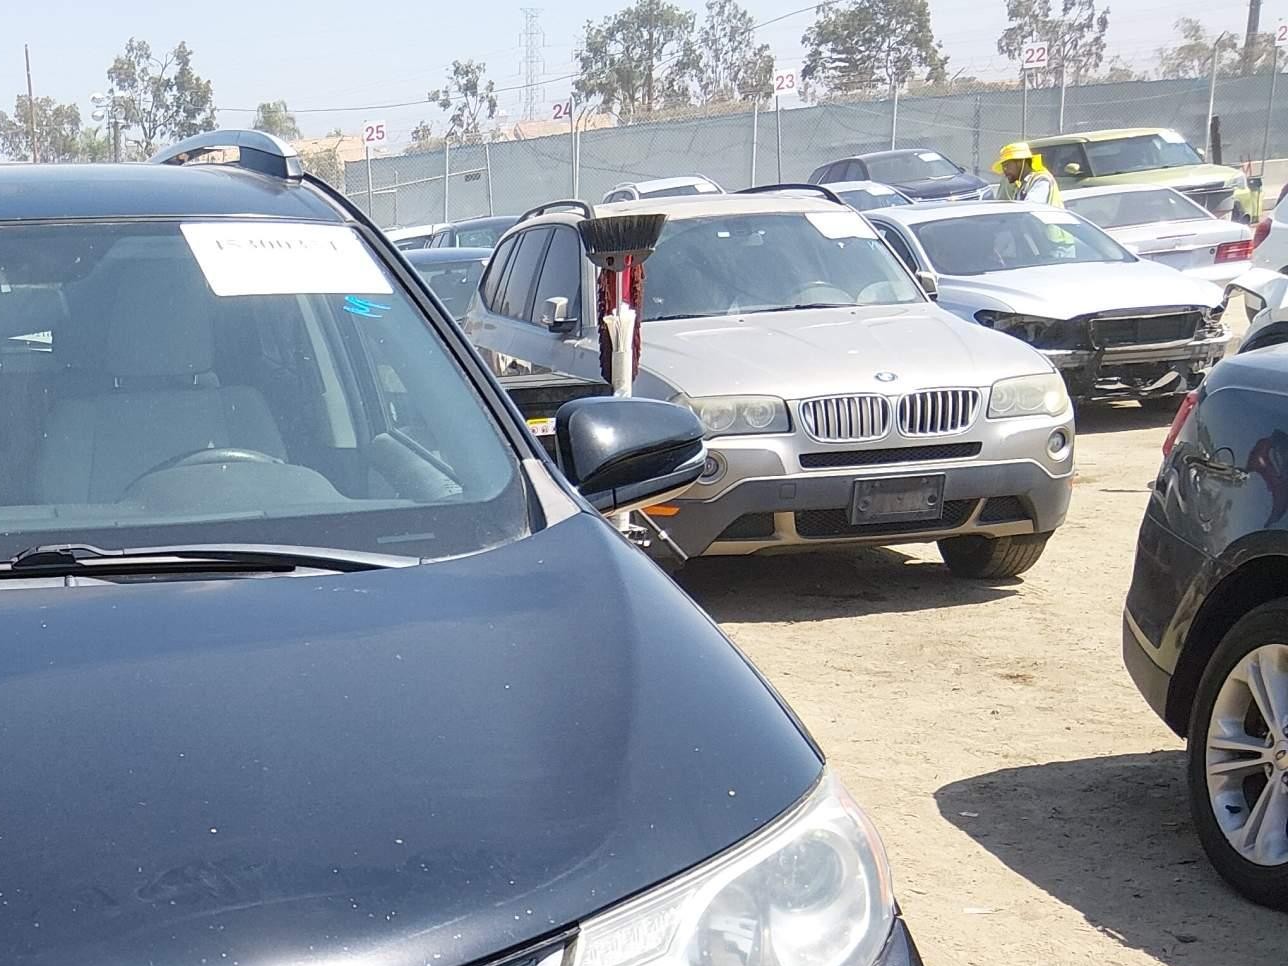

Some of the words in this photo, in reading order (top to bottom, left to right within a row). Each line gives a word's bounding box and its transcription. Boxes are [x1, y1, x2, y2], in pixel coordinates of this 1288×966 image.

[1025, 46, 1046, 64] 22
[775, 73, 795, 91] 23
[552, 102, 572, 120] 24
[365, 124, 385, 142] 25
